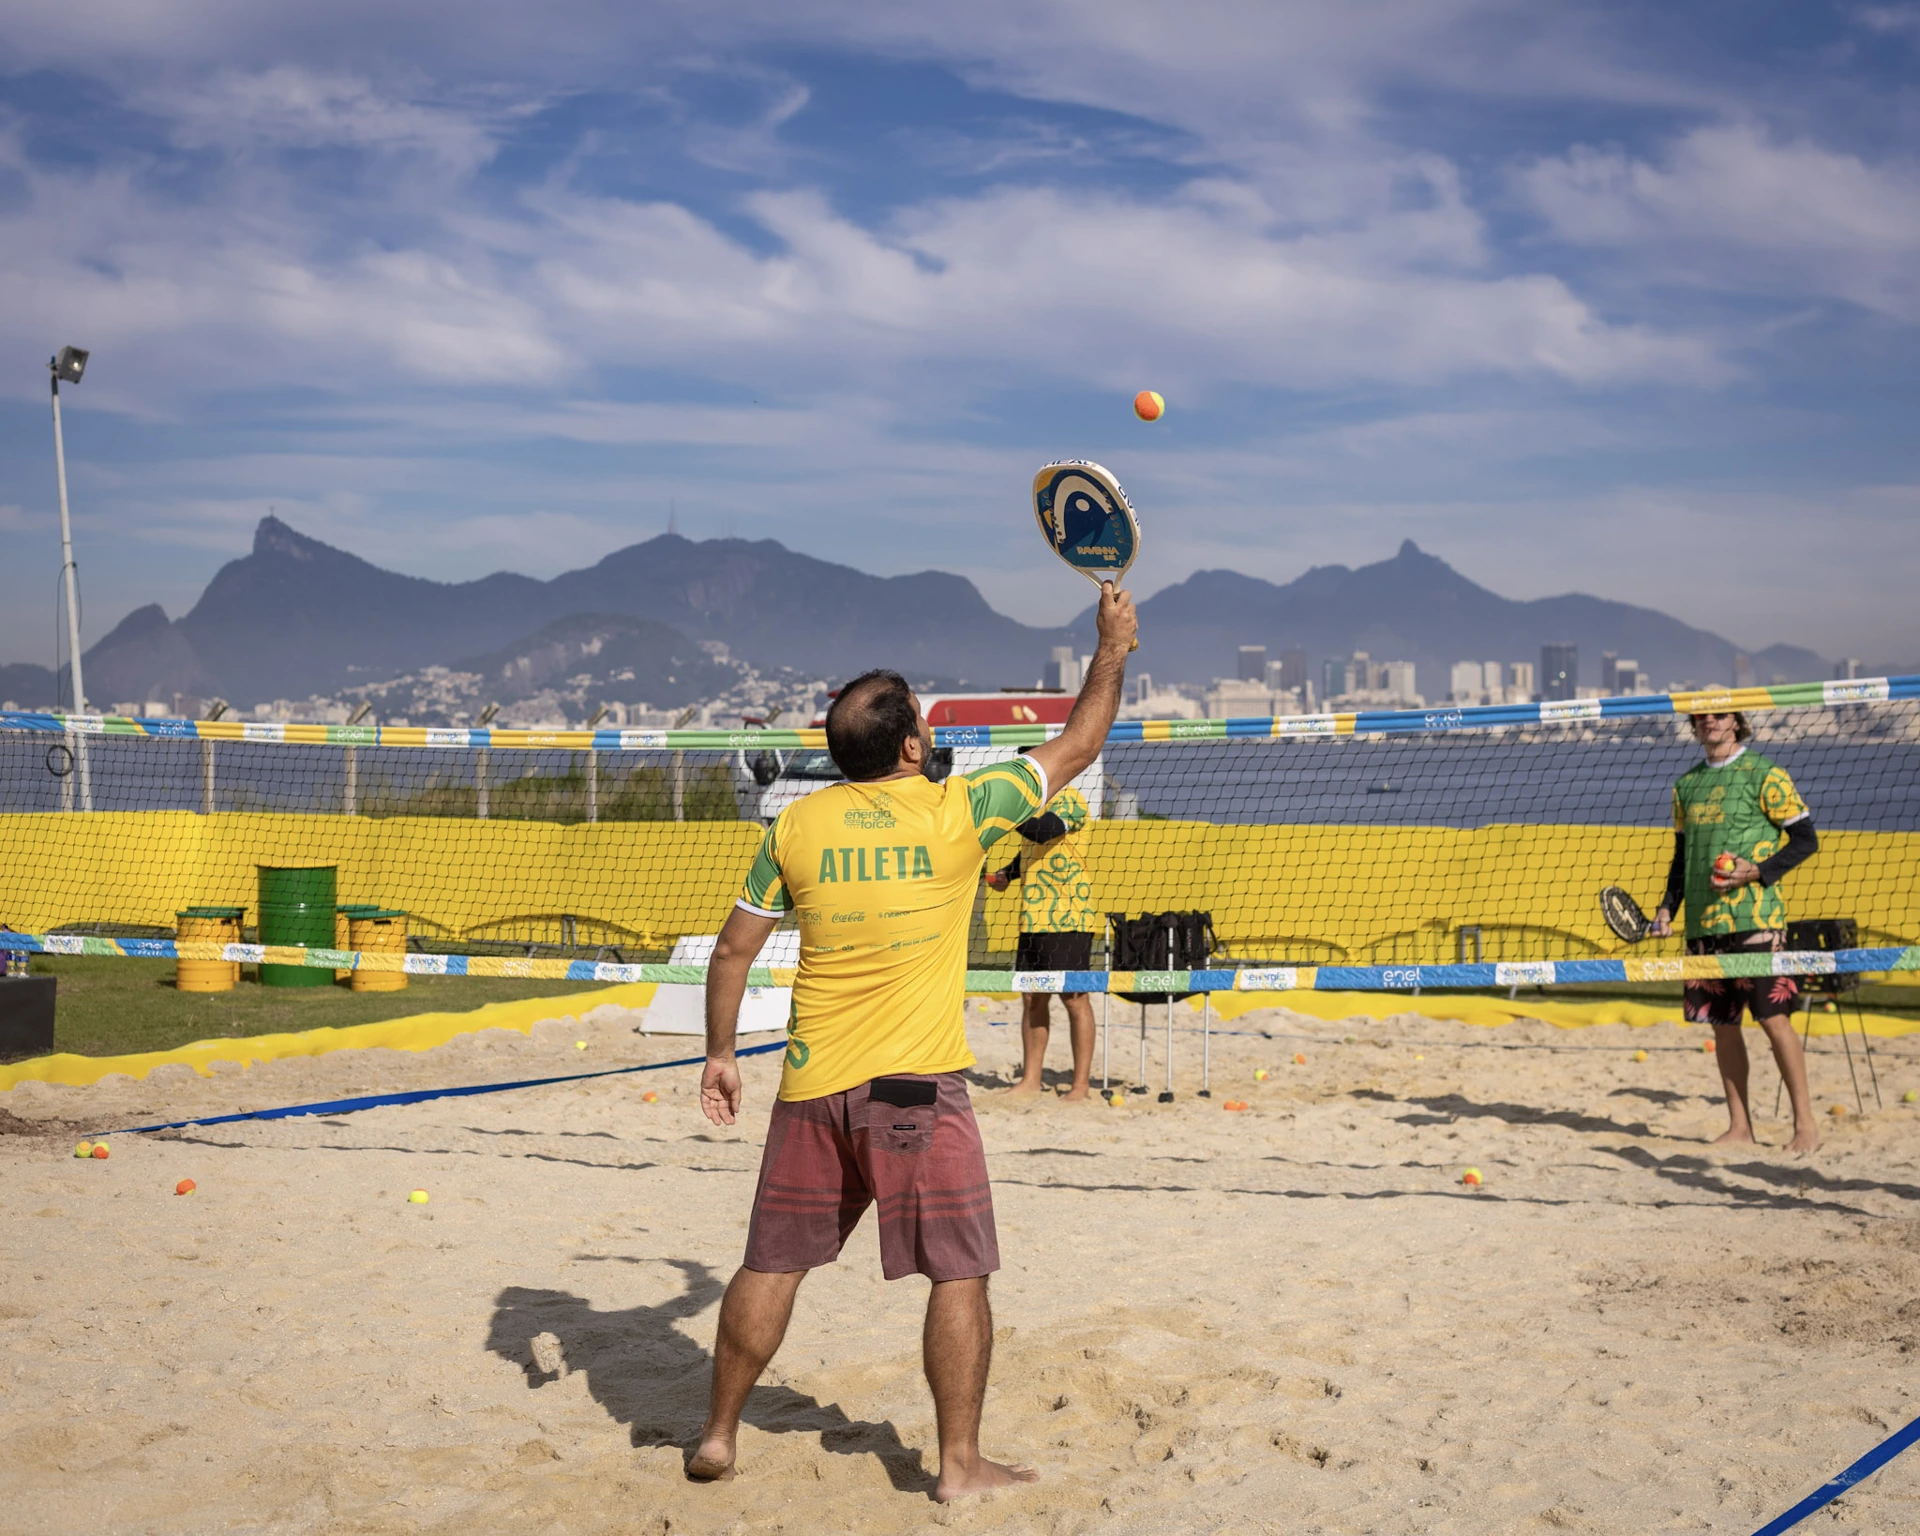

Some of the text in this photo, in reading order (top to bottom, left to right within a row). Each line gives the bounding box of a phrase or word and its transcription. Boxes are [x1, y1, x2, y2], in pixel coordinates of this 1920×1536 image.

[1076, 546, 1120, 555] RAVENNA
[844, 808, 892, 820] energia
[860, 818, 896, 829] torcer
[819, 846, 934, 884] ATLETA
[802, 911, 822, 921] enel
[1643, 959, 1683, 974] enel
[1141, 972, 1175, 986] enel
[1383, 967, 1420, 981] enel
